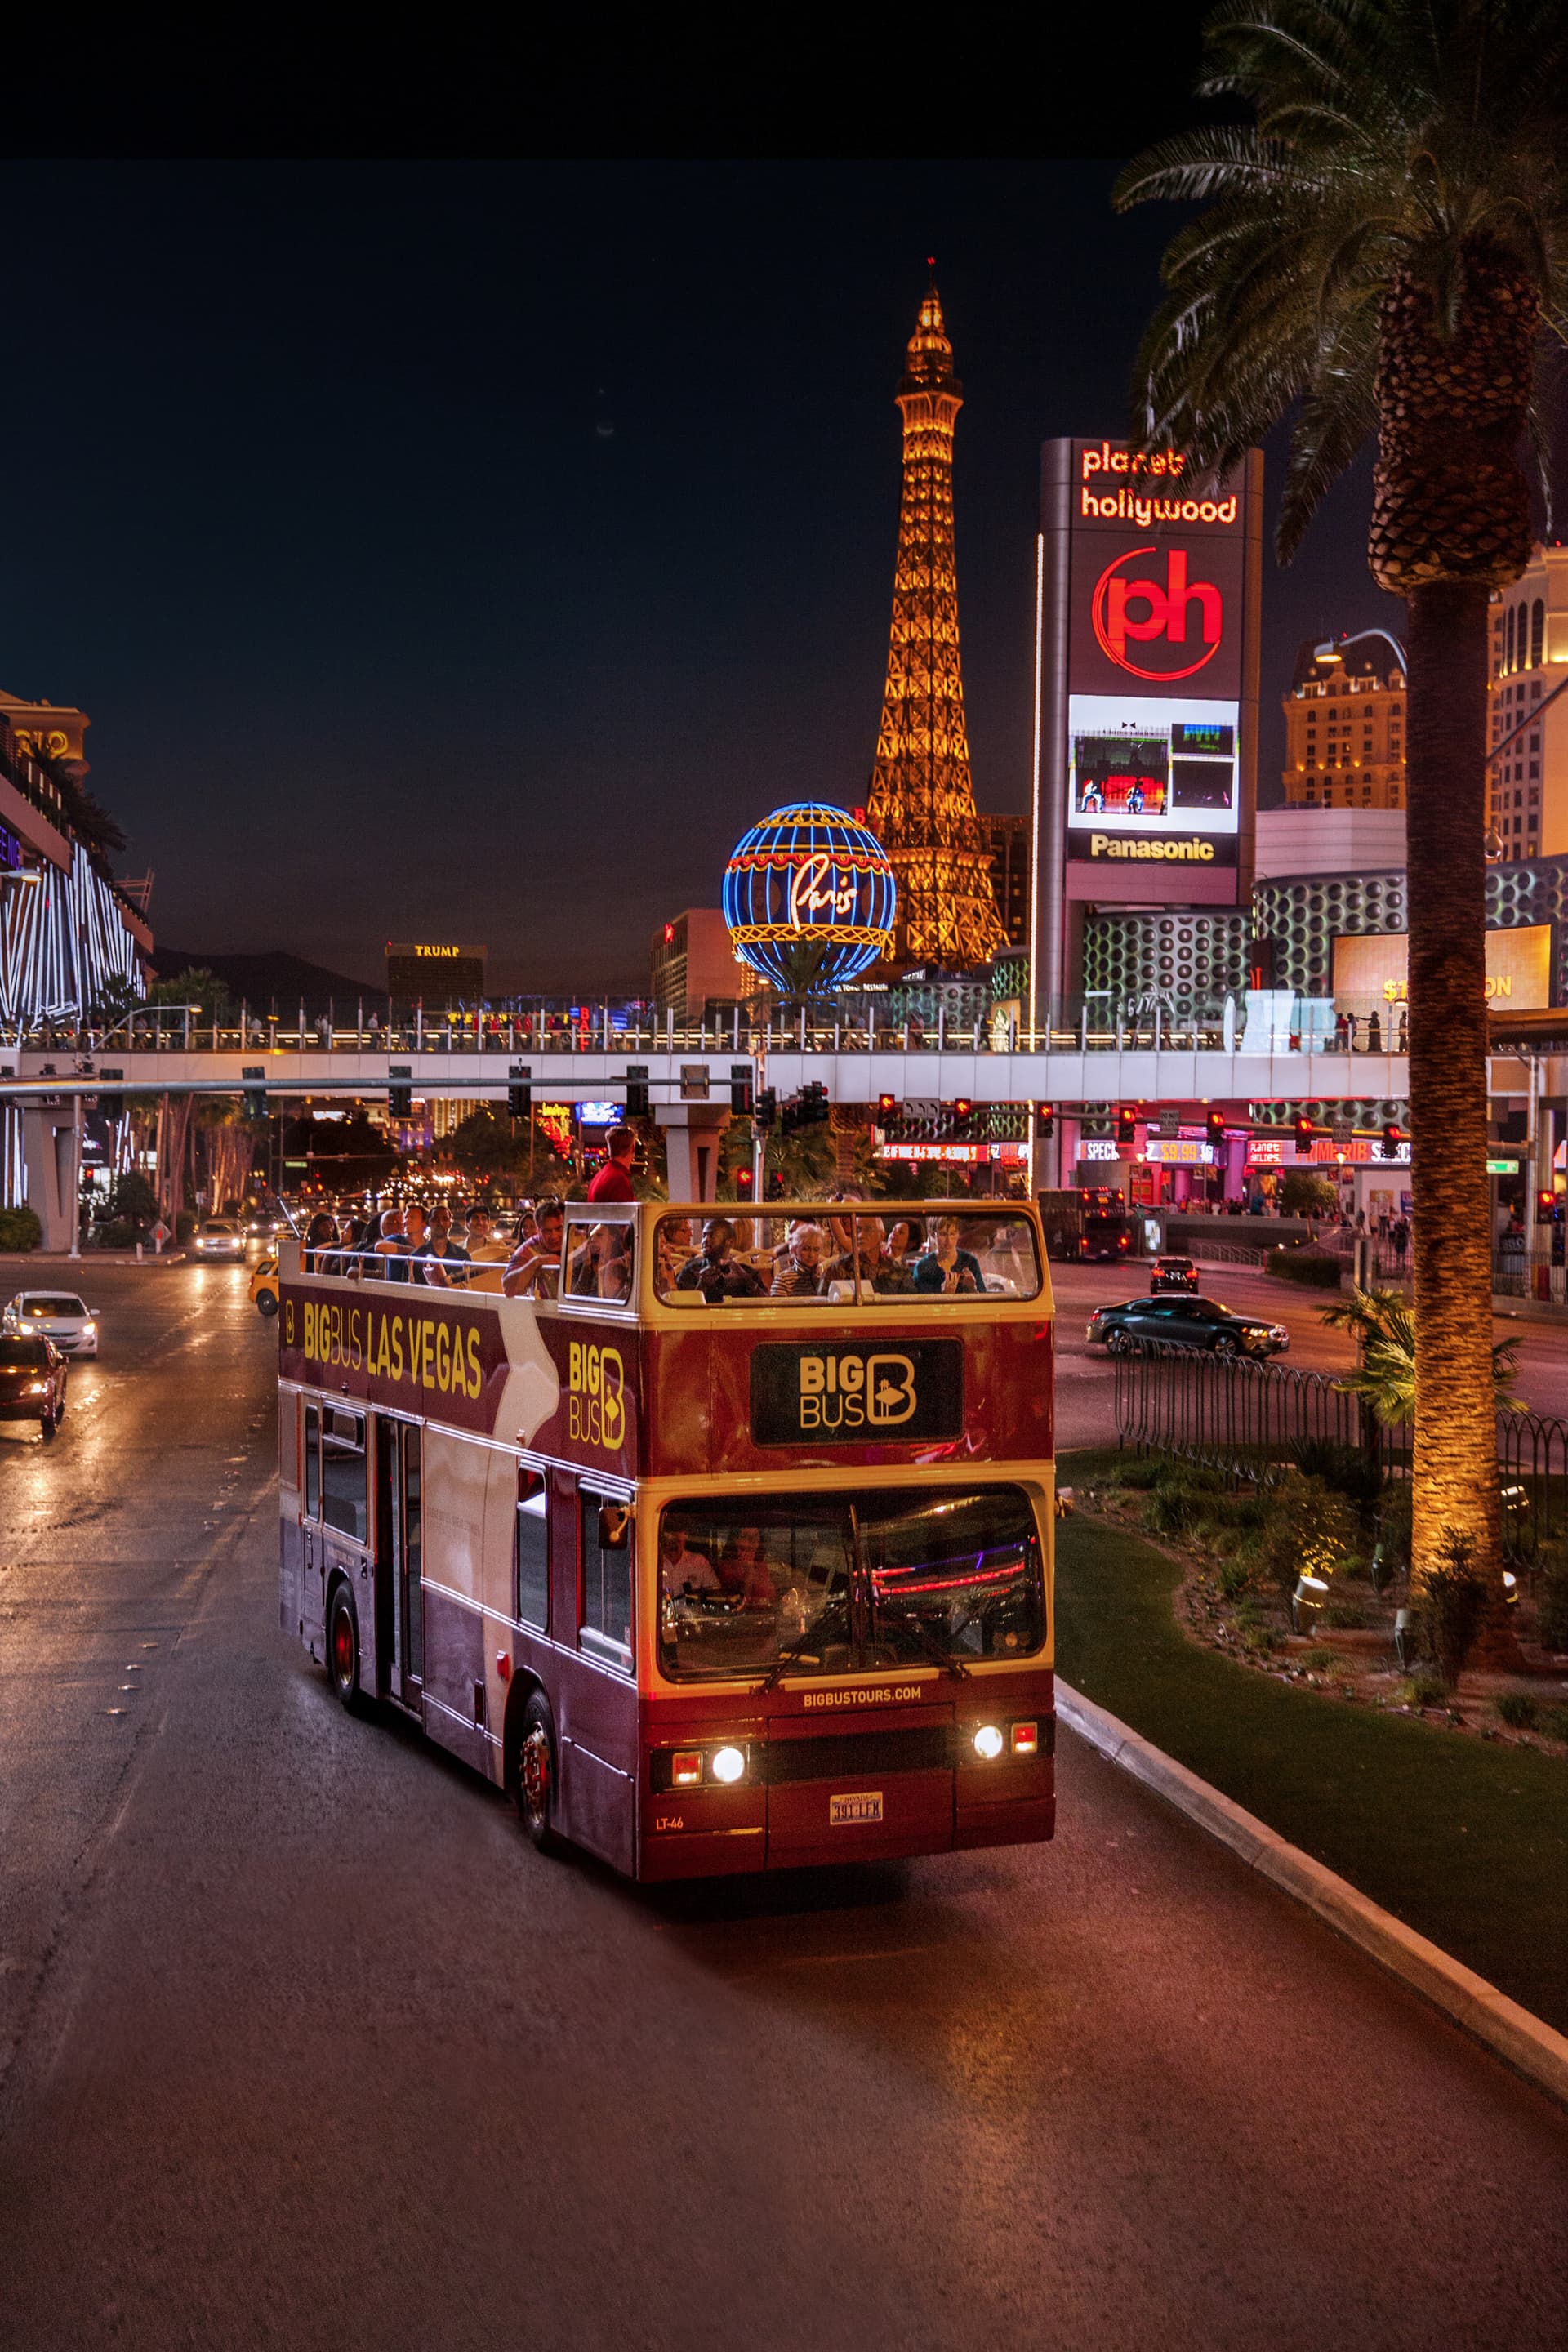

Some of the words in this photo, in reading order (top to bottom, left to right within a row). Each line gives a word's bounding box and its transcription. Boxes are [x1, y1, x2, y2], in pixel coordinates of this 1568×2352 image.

[1082, 440, 1185, 480] planet
[1081, 486, 1237, 527] hollywood
[1090, 833, 1215, 861] Panasonic
[791, 853, 858, 933] Paris
[414, 944, 460, 958] TRUMP
[1160, 1143, 1197, 1161] $9.99
[368, 1311, 403, 1381] LAS
[408, 1316, 482, 1399] VEGAS
[569, 1341, 599, 1395] BIG
[800, 1355, 865, 1394] BIG
[569, 1395, 600, 1445] BUS
[800, 1393, 865, 1428] BUS
[804, 1686, 921, 1708] BIGBUSTOURS.COM
[656, 1816, 684, 1830] LT-46
